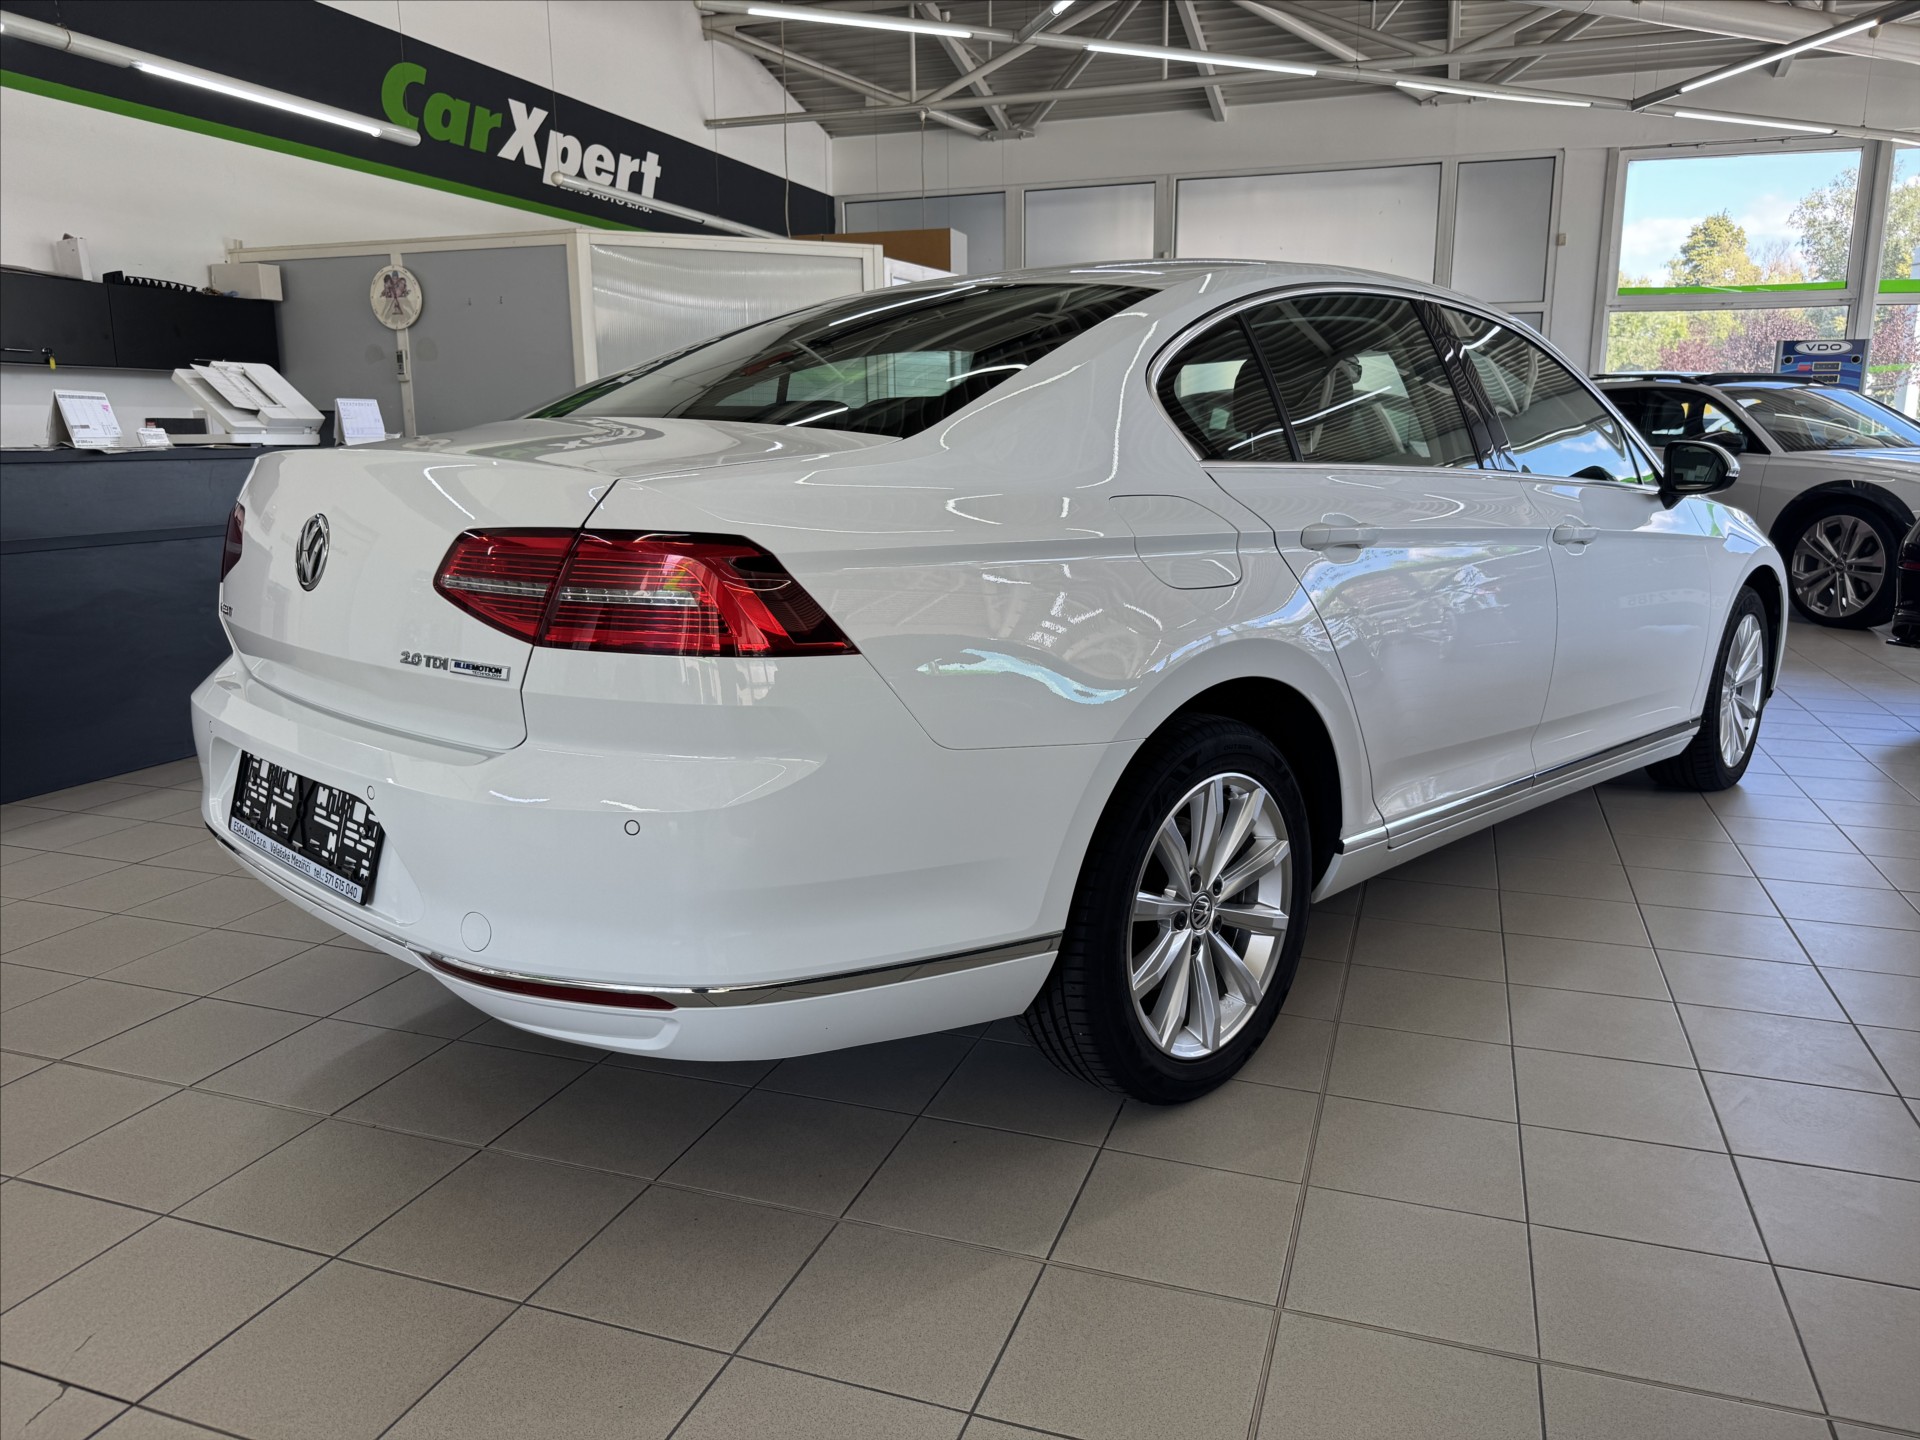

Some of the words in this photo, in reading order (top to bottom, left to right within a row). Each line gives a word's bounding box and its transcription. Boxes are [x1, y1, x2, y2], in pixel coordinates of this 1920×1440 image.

[1806, 343, 1842, 352] VDO
[423, 654, 449, 671] TDI
[454, 661, 502, 675] BLUEMOTION
[233, 820, 245, 836] ESAS
[244, 828, 257, 842] AUTO
[257, 836, 267, 849] s.r.o.
[270, 841, 291, 862] Valašské
[324, 872, 335, 886] 571
[334, 877, 345, 892] 615
[345, 883, 358, 899] 040
